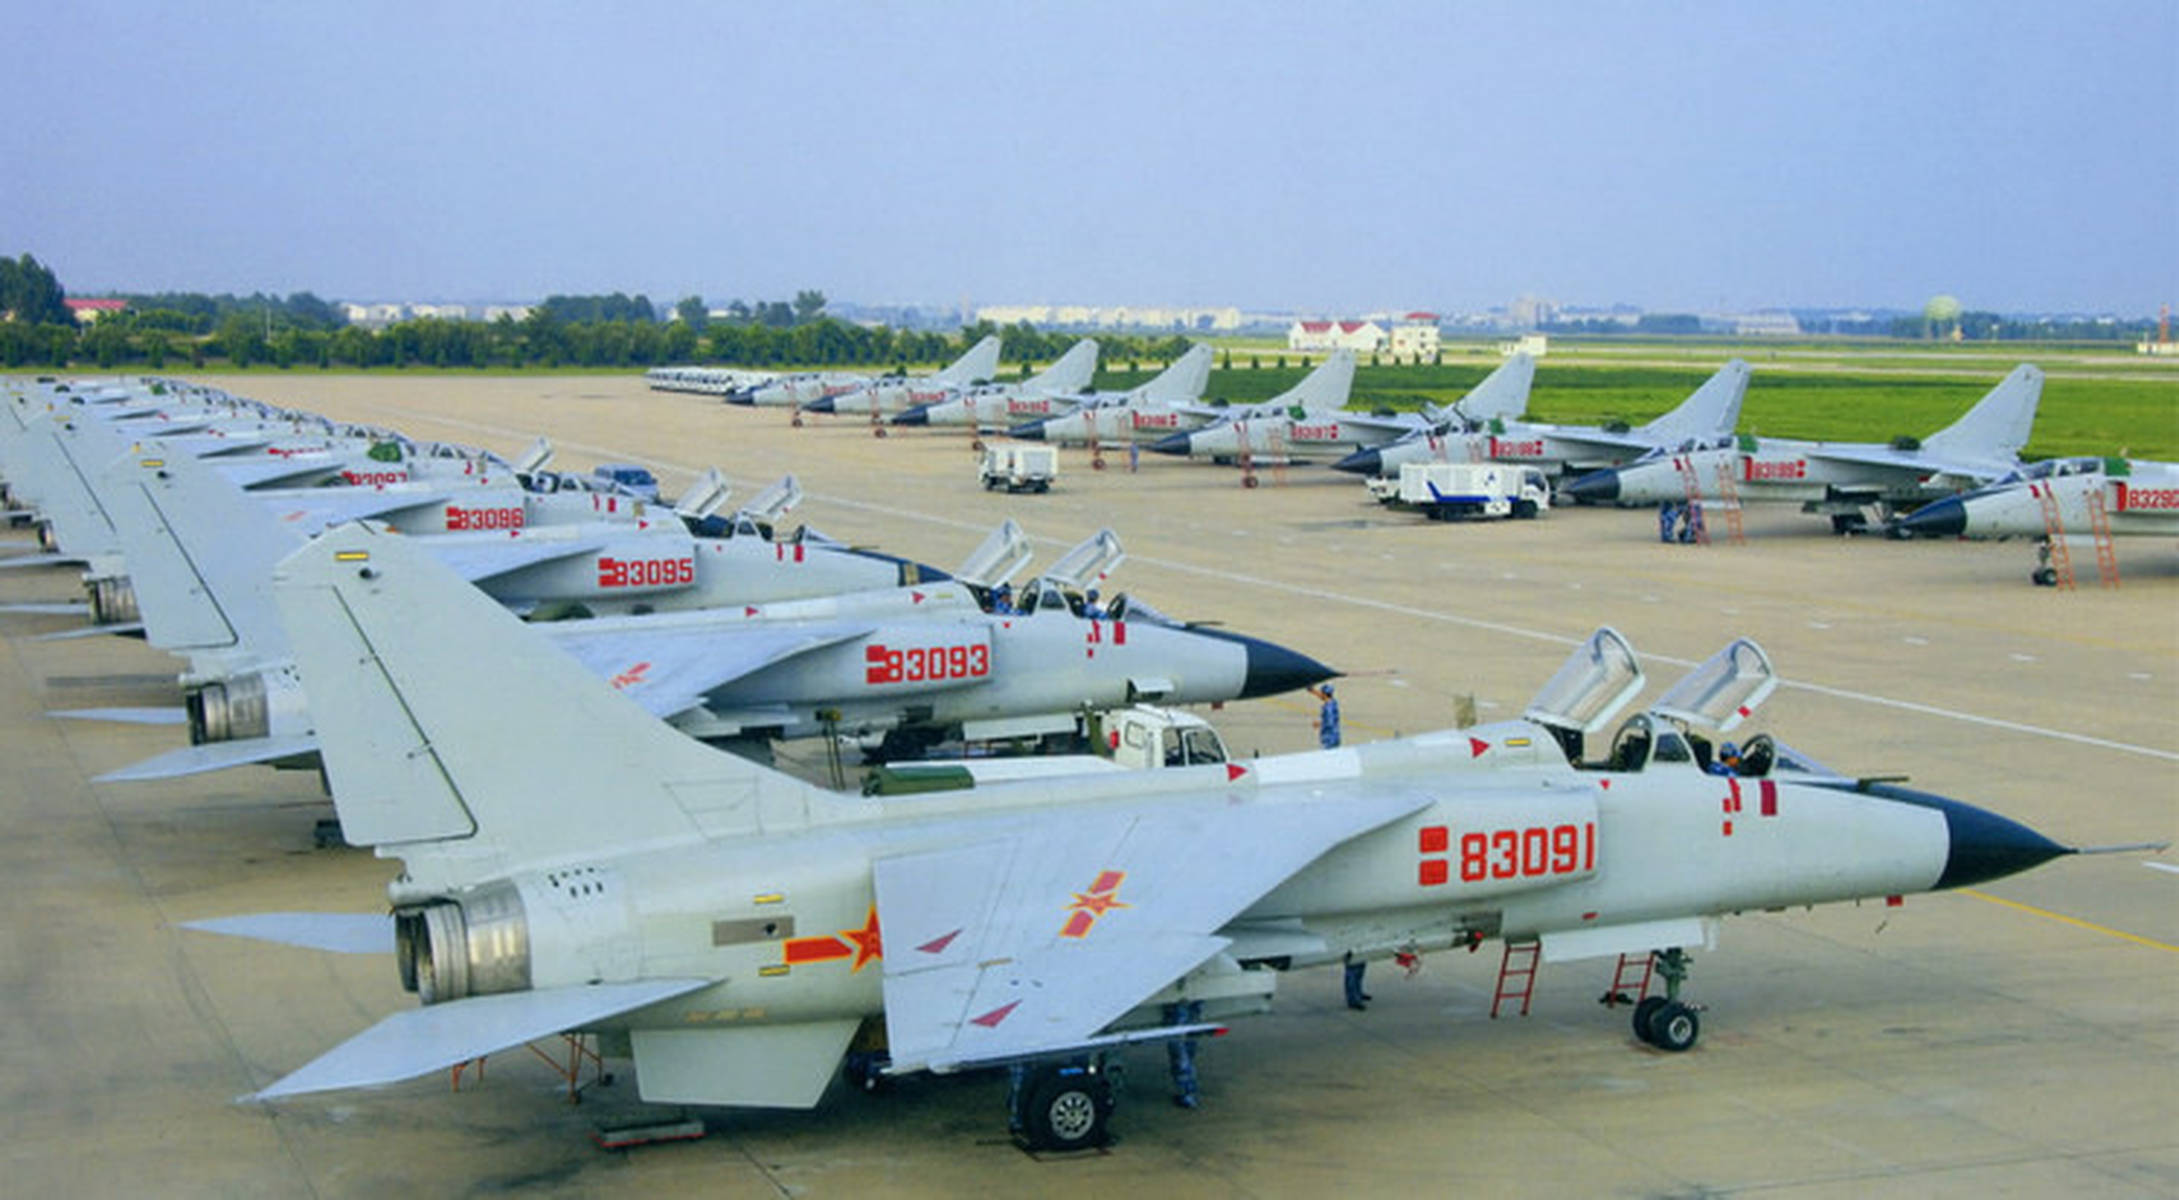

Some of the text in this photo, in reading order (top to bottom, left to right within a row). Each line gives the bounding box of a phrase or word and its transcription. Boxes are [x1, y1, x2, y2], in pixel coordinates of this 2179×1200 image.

[459, 507, 524, 530] 83096
[614, 557, 694, 587] 83095
[884, 644, 990, 684] 83093
[1461, 822, 1595, 882] 83091
